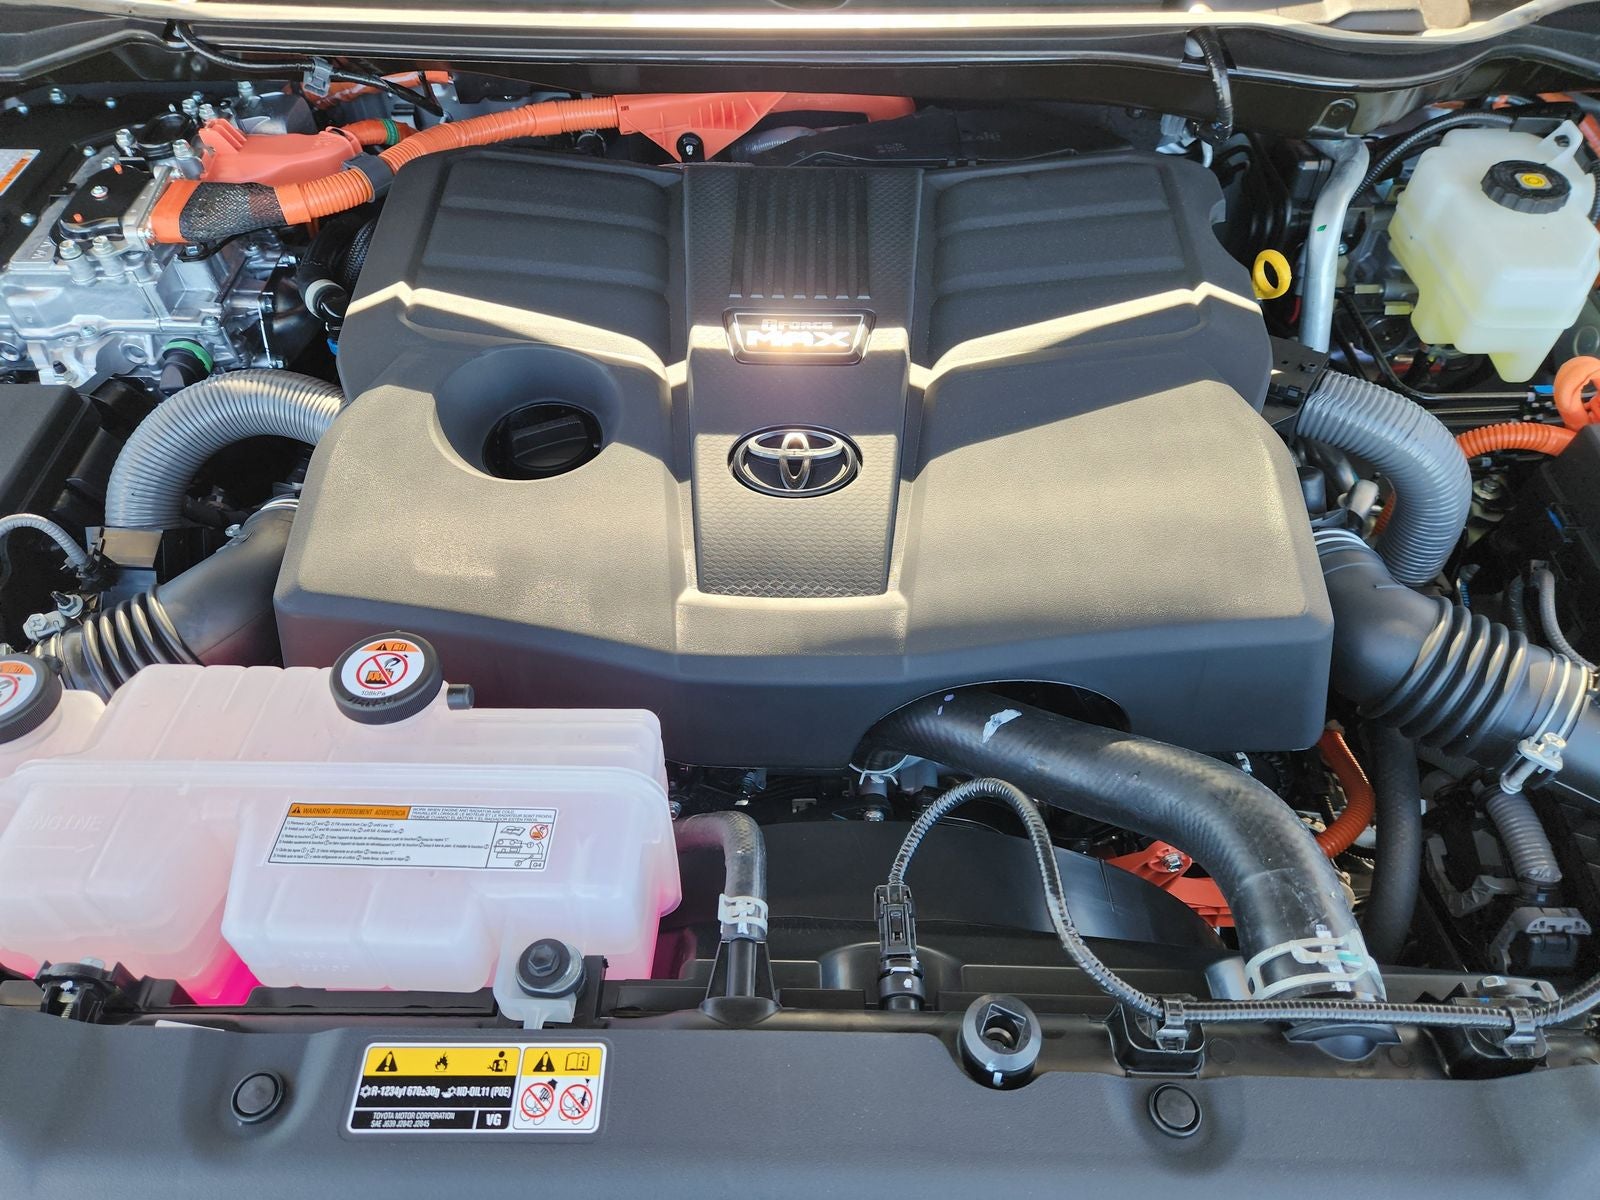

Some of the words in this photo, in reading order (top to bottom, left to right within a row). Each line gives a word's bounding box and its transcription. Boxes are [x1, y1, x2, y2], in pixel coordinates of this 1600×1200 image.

[746, 331, 850, 346] MAX
[371, 1086, 406, 1098] R-1234yf
[490, 1086, 511, 1099] (POE)
[486, 1113, 502, 1126] VG
